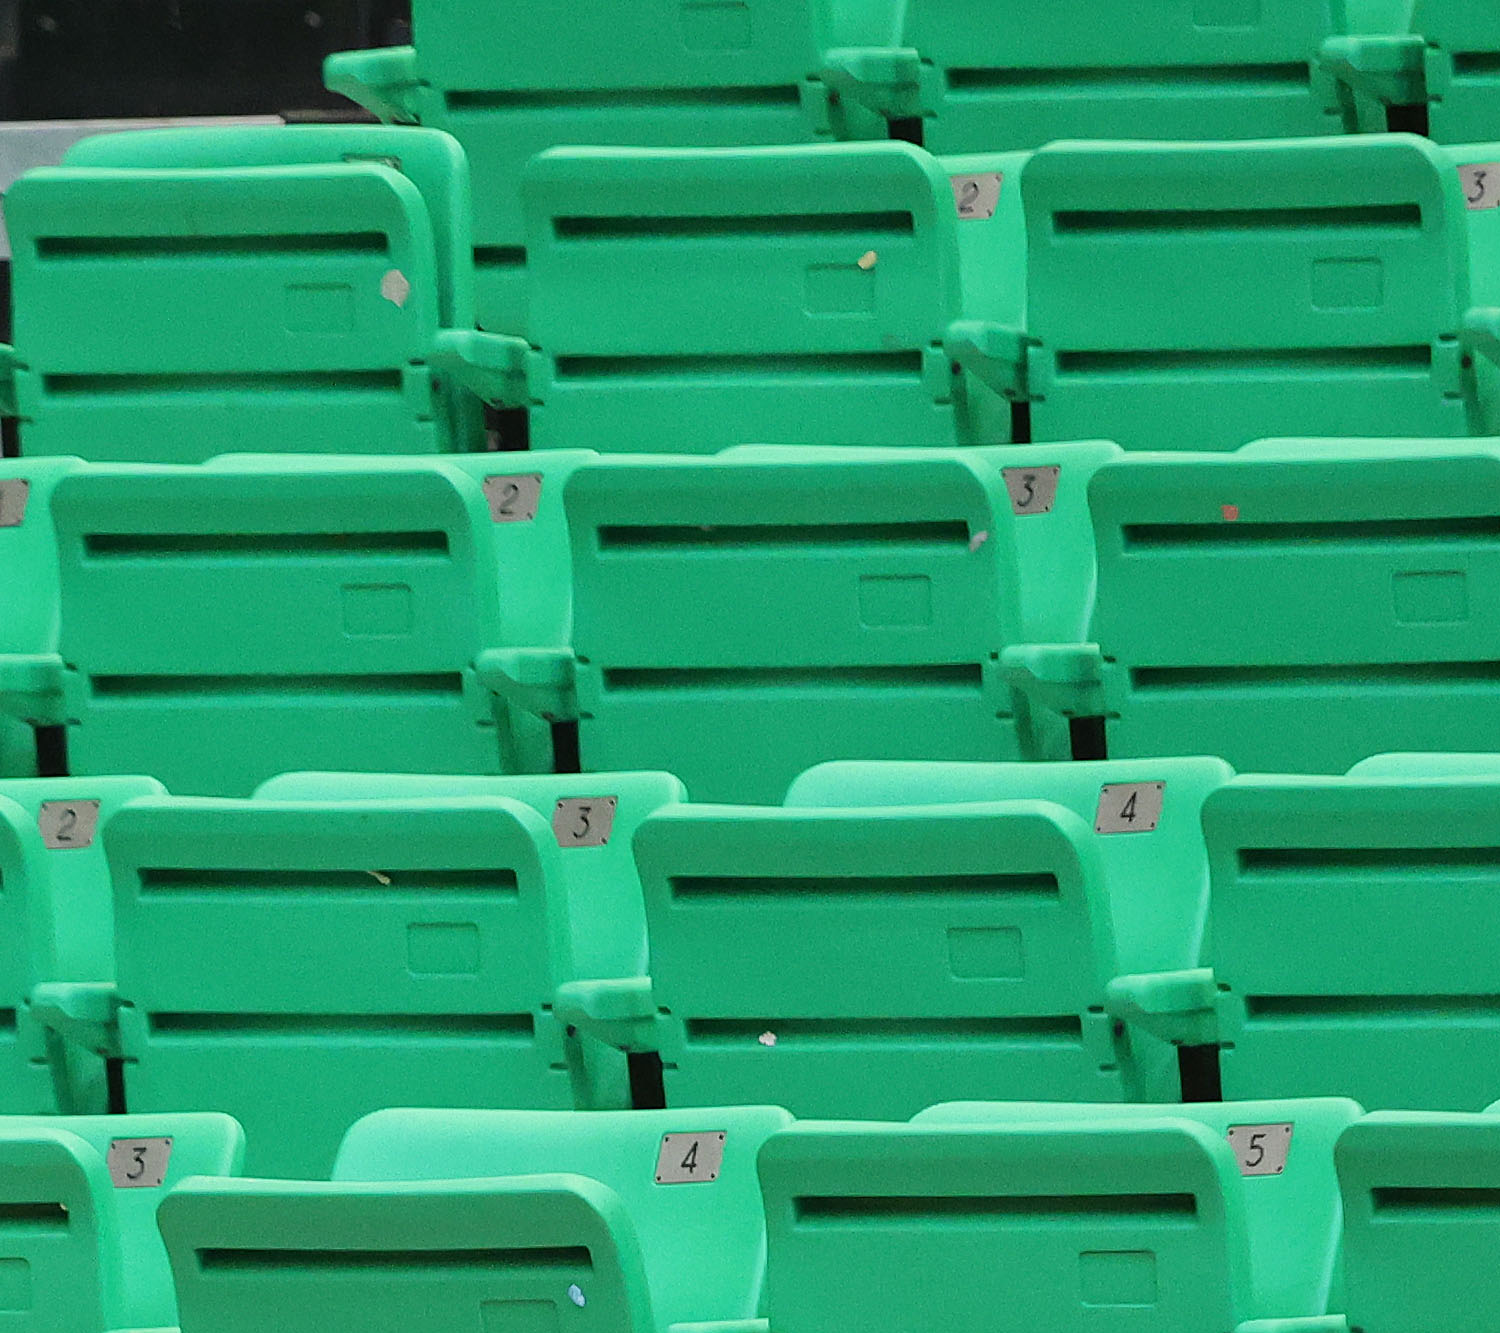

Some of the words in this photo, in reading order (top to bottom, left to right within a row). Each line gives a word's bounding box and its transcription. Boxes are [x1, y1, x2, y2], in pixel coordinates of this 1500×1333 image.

[958, 182, 979, 213] 2
[1467, 170, 1487, 203] 3
[499, 484, 520, 514] 2
[1017, 474, 1037, 507] 3
[572, 806, 592, 838] 3
[1120, 791, 1138, 822] 4
[56, 809, 77, 840] 2
[126, 1147, 147, 1180] 3
[681, 1141, 699, 1174] 4
[1245, 1134, 1267, 1167] 5
